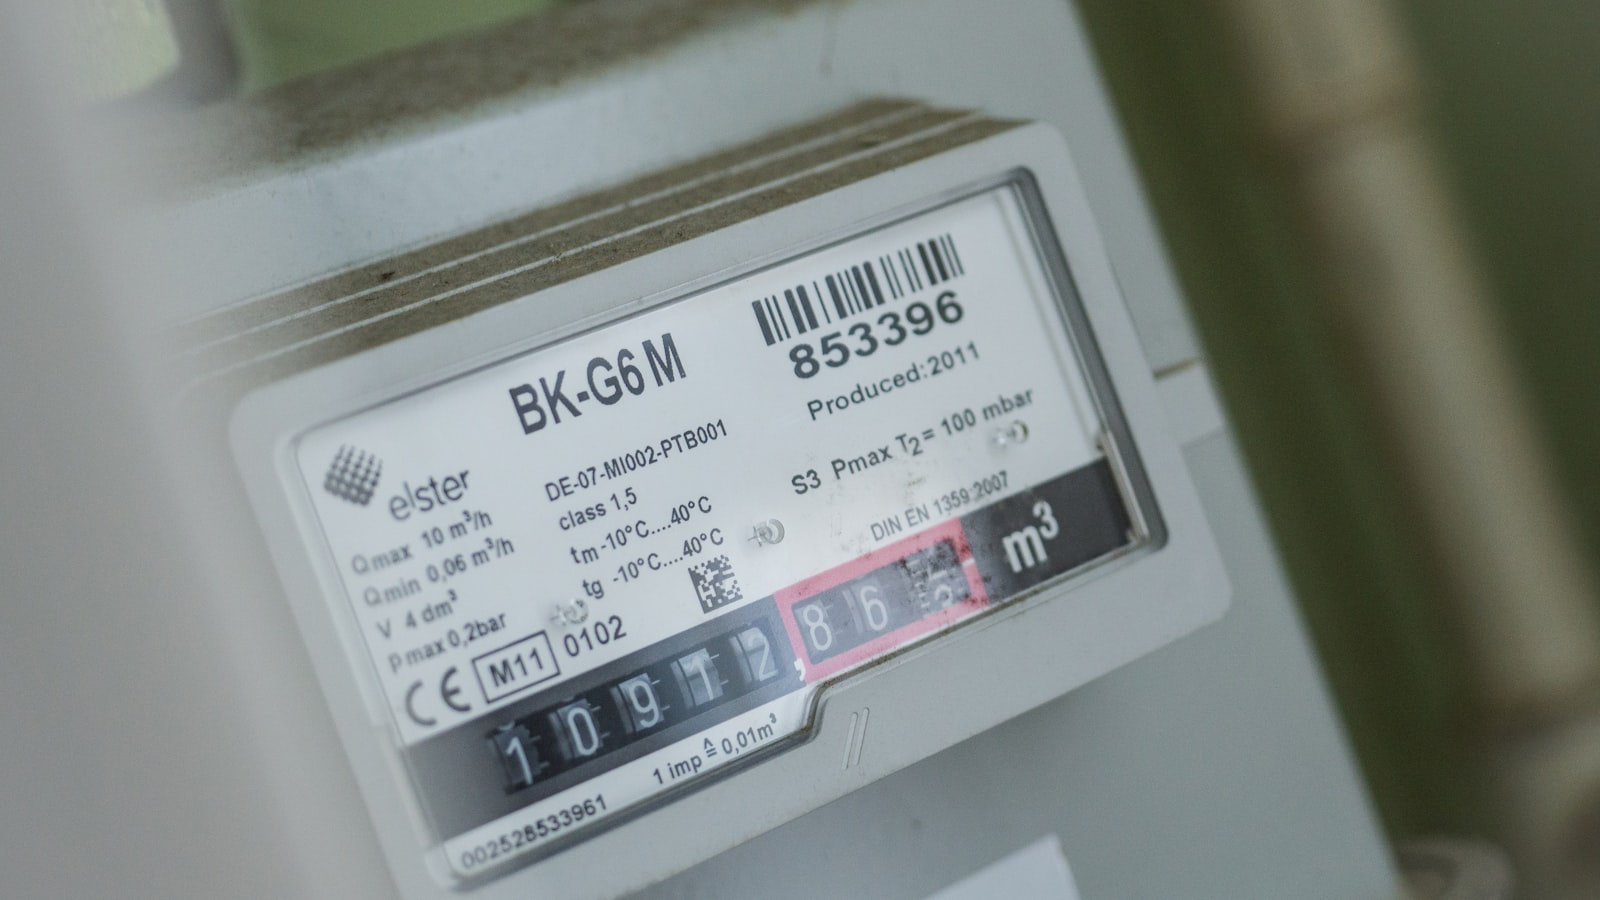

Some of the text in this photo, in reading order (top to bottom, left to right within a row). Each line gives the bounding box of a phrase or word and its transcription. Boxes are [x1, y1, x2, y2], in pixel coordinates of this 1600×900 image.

[789, 290, 964, 379] 853396
[508, 348, 645, 435] BK-G6
[807, 341, 980, 421] Produced:2011
[545, 419, 727, 502] DE-07-MI002-PTB001
[791, 469, 821, 495] S3
[831, 445, 893, 480] Pmax
[941, 408, 976, 436] 100
[982, 389, 1034, 421] mbar
[389, 470, 469, 521] elster
[559, 486, 637, 531] class 1,5
[421, 527, 444, 548] 10
[870, 516, 902, 542] DIN
[905, 505, 930, 528] EN
[427, 554, 466, 582] 0,06
[582, 579, 604, 599] tg
[377, 621, 392, 639] V
[406, 612, 417, 629] 4
[489, 647, 544, 688] M11
[564, 615, 627, 657] 0102
[652, 768, 664, 785] 1
[668, 754, 703, 779] imp
[461, 793, 608, 870] 002528533961
